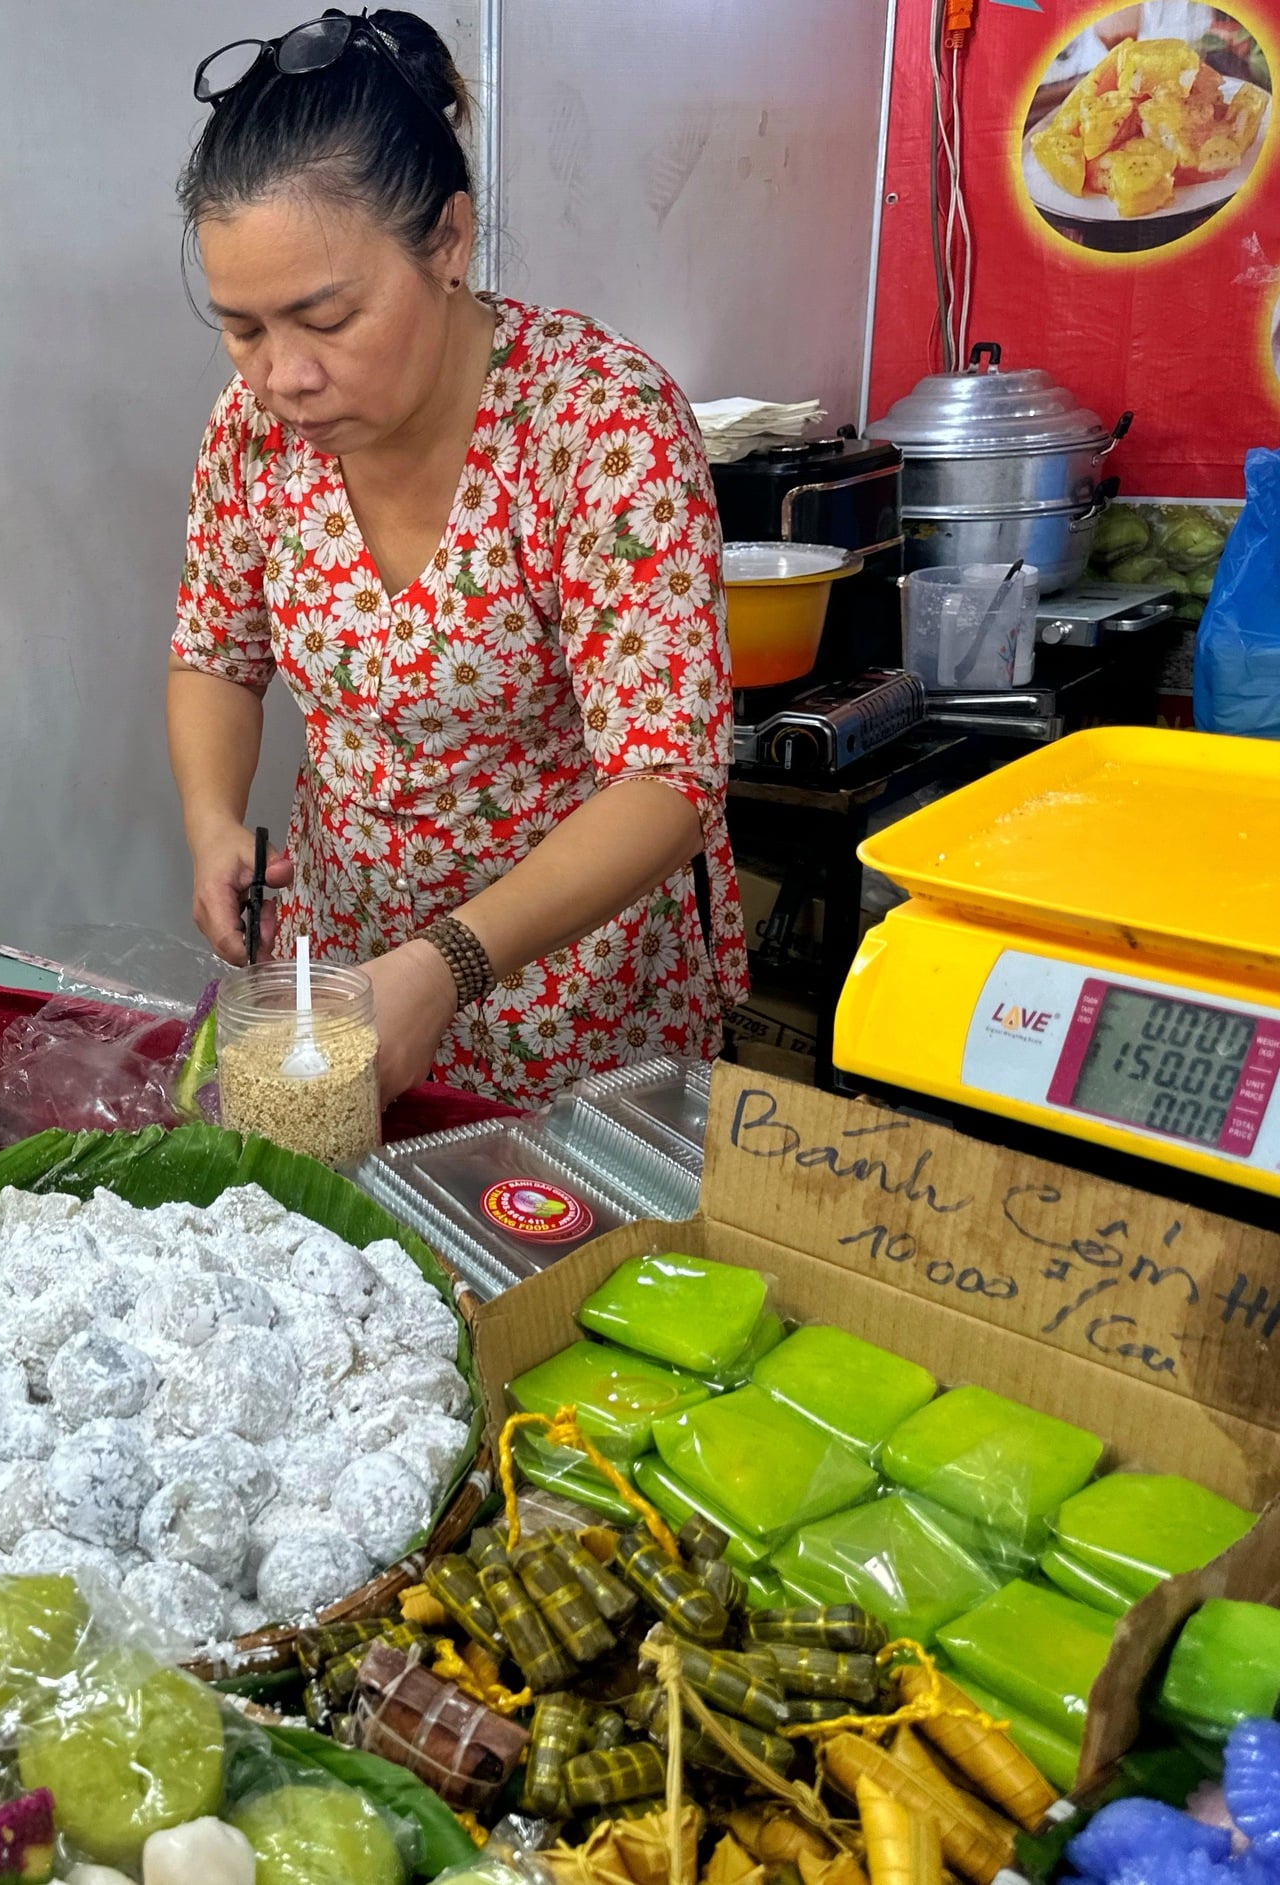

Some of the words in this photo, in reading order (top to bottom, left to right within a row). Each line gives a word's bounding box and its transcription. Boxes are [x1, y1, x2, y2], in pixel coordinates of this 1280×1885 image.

[1256, 1036, 1280, 1050] WEIGH
[1245, 1079, 1265, 1092] UNIT
[1239, 1088, 1265, 1103] PRICE
[1232, 1118, 1255, 1132] TOTAL
[1228, 1127, 1254, 1141] PRICE
[518, 1223, 550, 1231] FOOD
